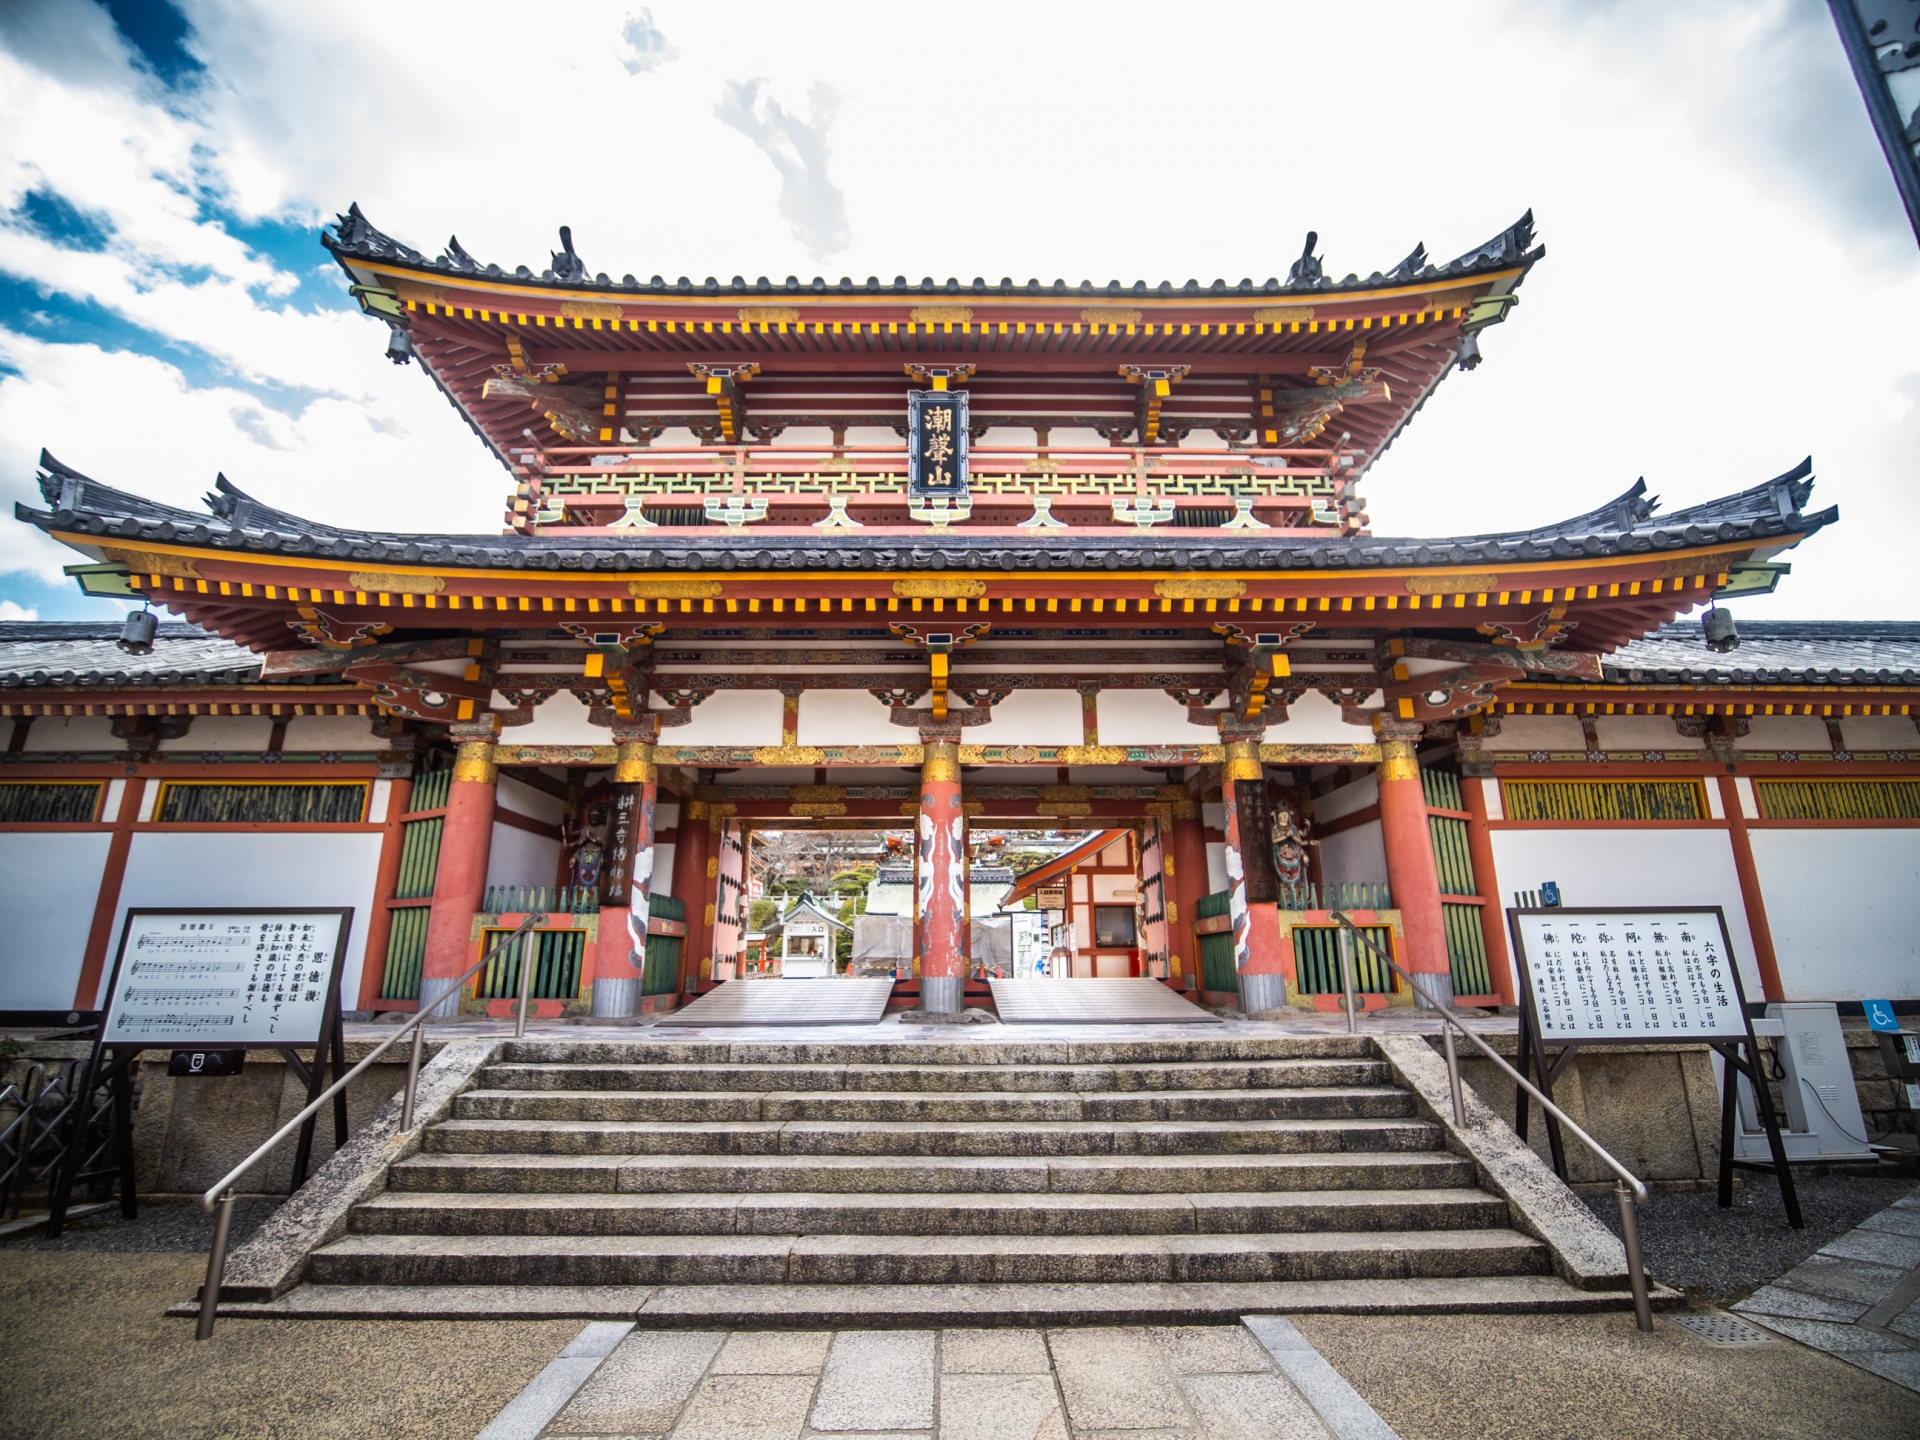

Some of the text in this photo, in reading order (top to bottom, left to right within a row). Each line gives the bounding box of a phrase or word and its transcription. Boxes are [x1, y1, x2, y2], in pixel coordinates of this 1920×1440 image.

[924, 405, 954, 486] 潮聲山
[1704, 941, 1728, 1007] 六字の生活
